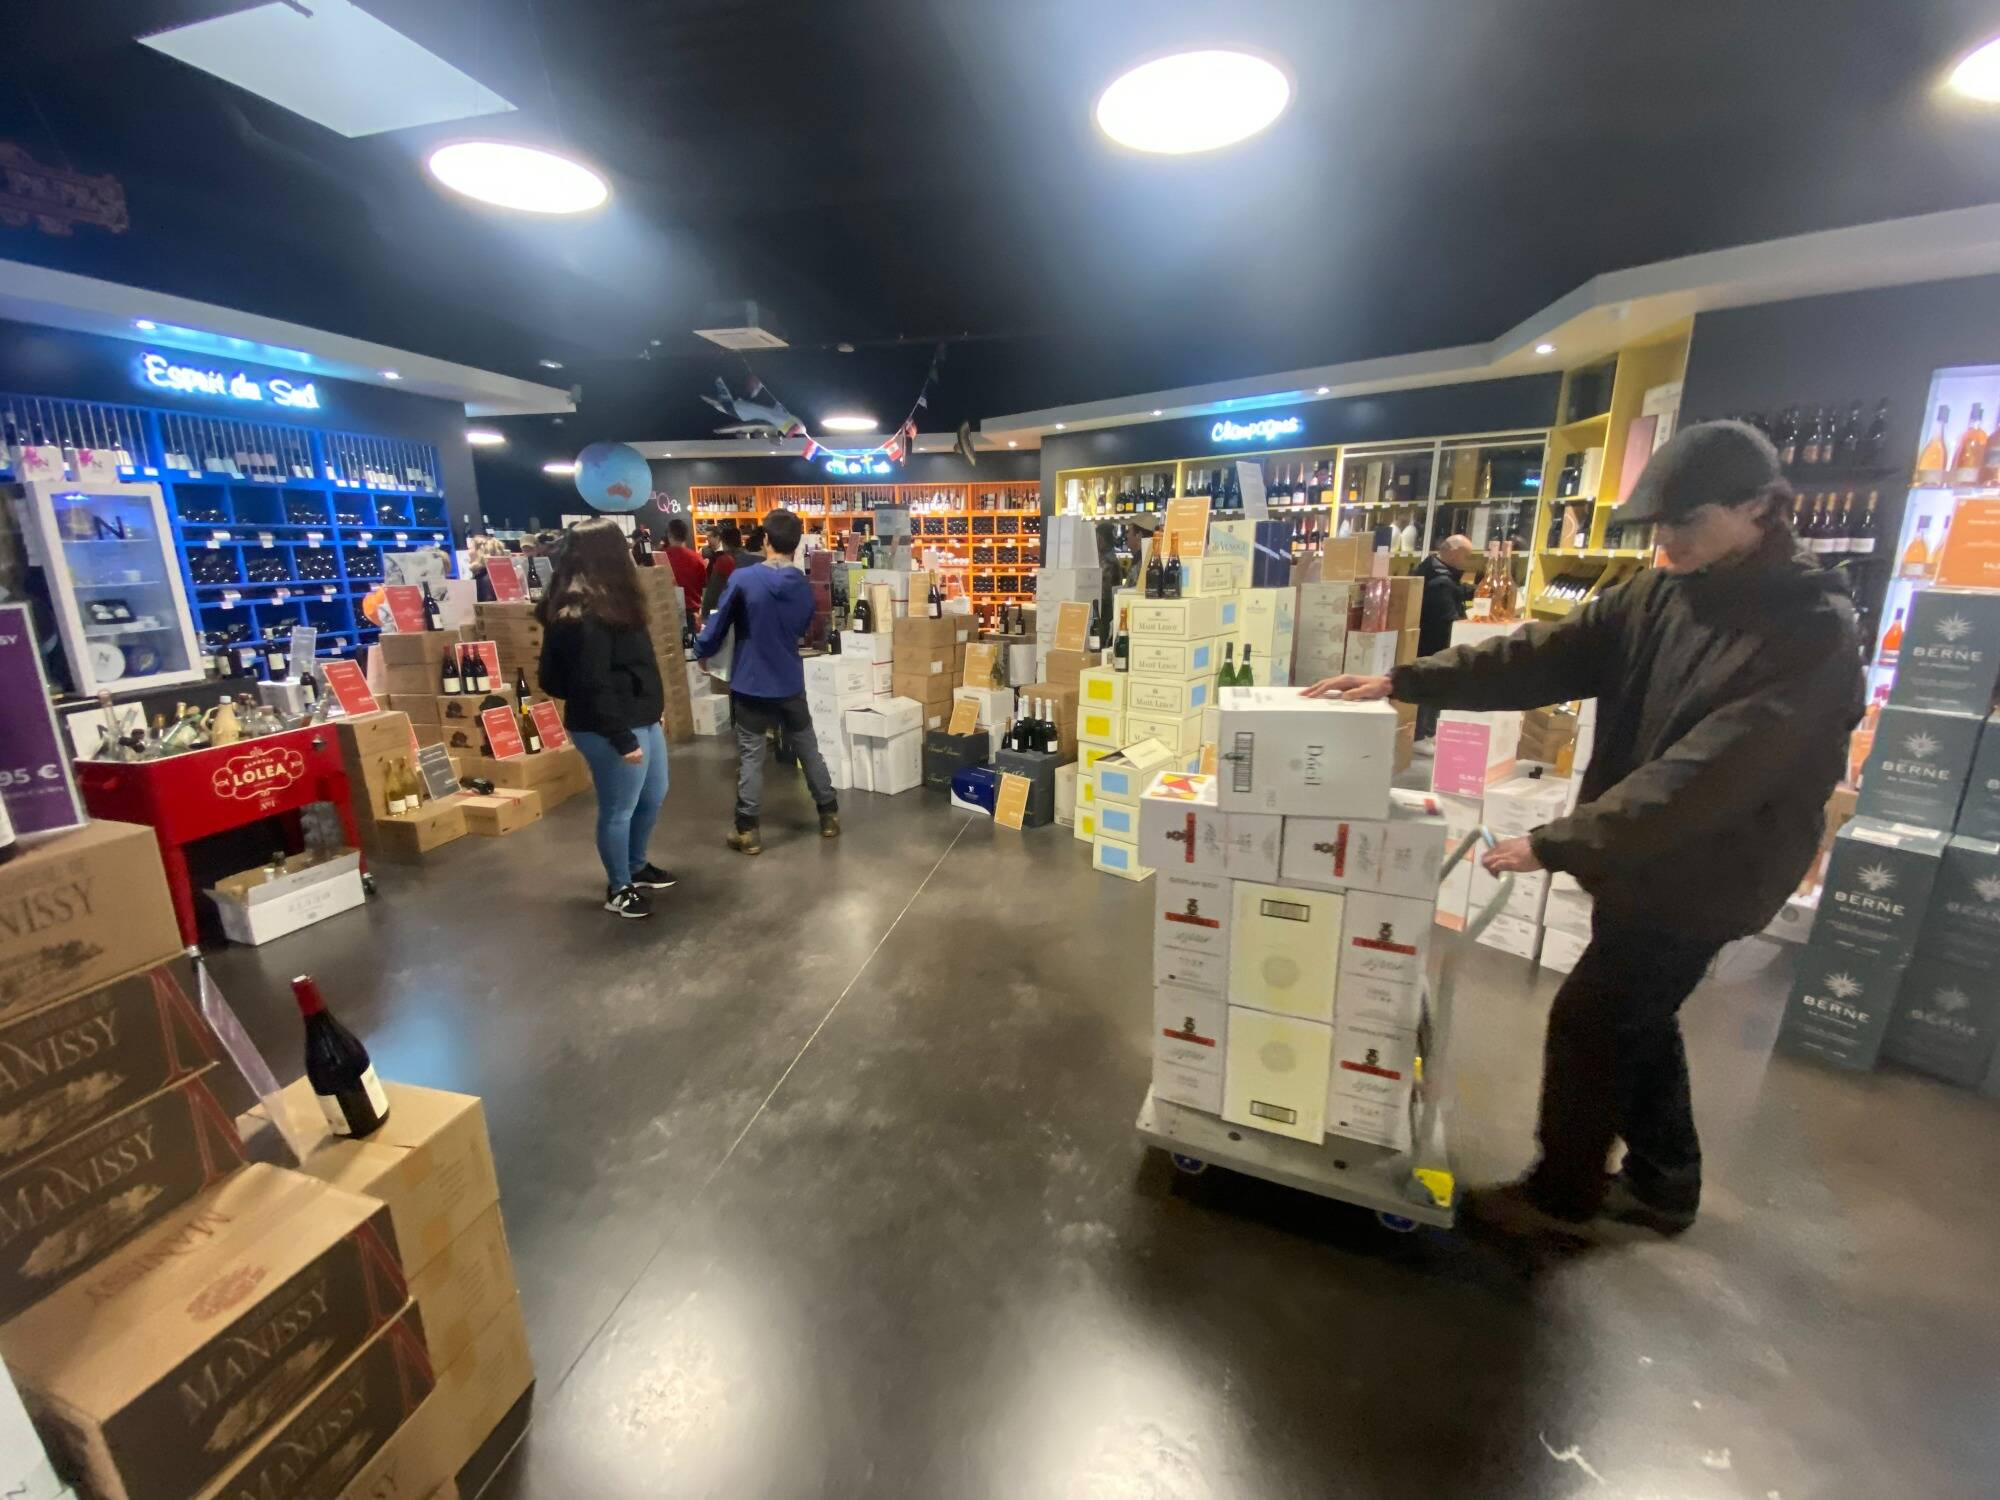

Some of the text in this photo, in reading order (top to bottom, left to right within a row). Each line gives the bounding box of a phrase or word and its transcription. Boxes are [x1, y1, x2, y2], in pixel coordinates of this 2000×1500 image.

[1912, 646, 1983, 662] BERNE
[232, 762, 288, 787] LOLEA
[1881, 760, 1950, 781] BERNE
[1834, 890, 1905, 917] BERNE
[1803, 994, 1871, 1024] BERNE
[178, 1278, 328, 1428] MANISSY
